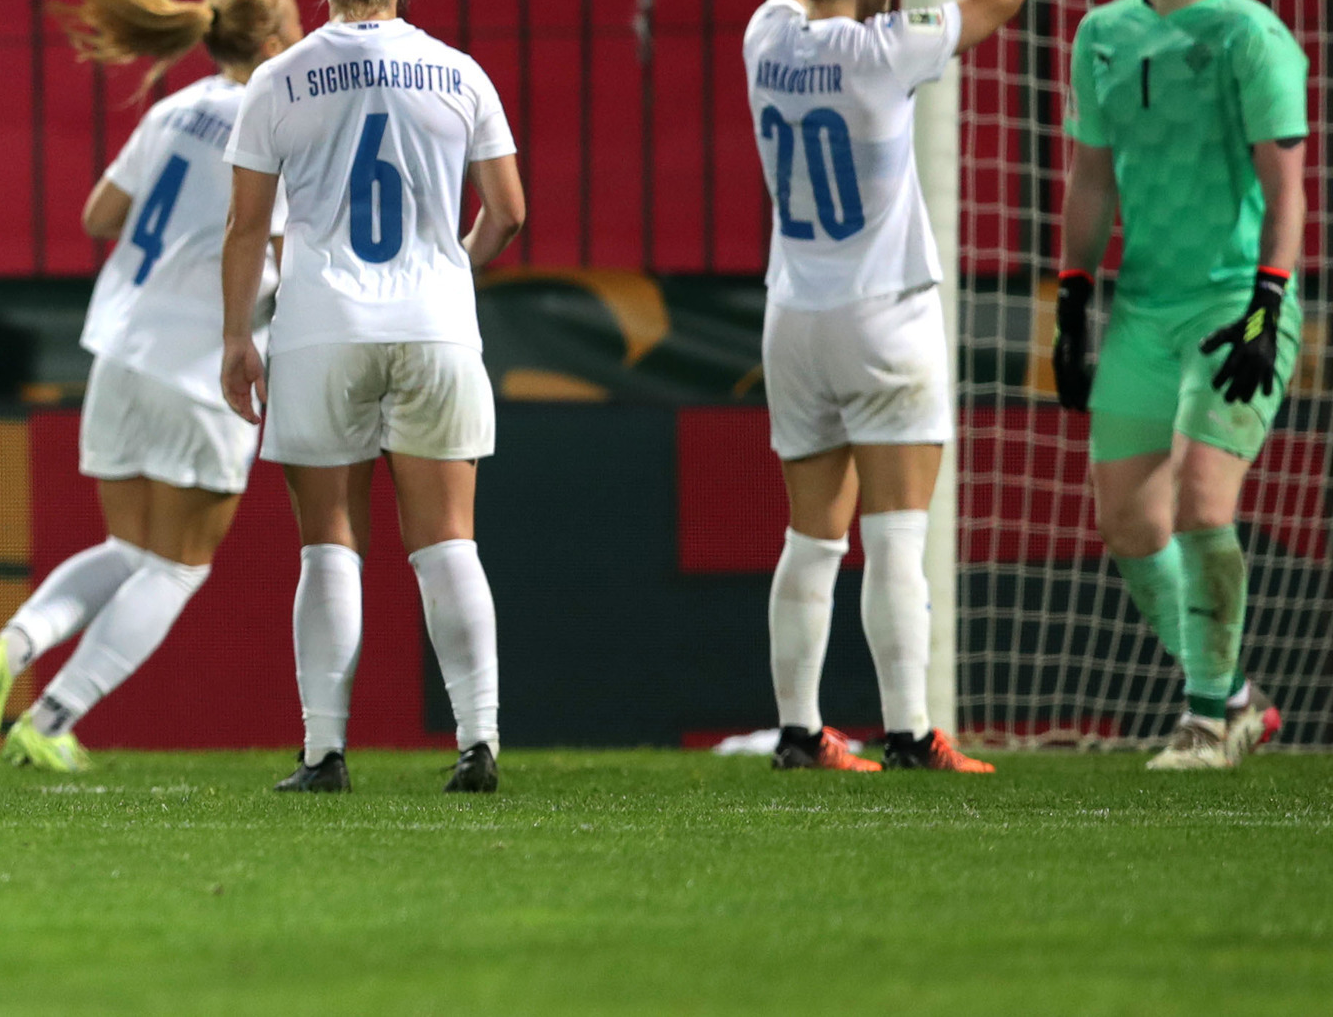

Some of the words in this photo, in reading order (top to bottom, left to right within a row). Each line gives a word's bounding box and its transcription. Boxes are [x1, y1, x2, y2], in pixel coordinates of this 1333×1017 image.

[286, 75, 301, 103] I.
[307, 58, 462, 97] SIGURÐARDÓTTIR
[1140, 56, 1151, 110] 1
[131, 154, 190, 286] 4
[349, 112, 404, 265] 6
[760, 105, 866, 242] 20
